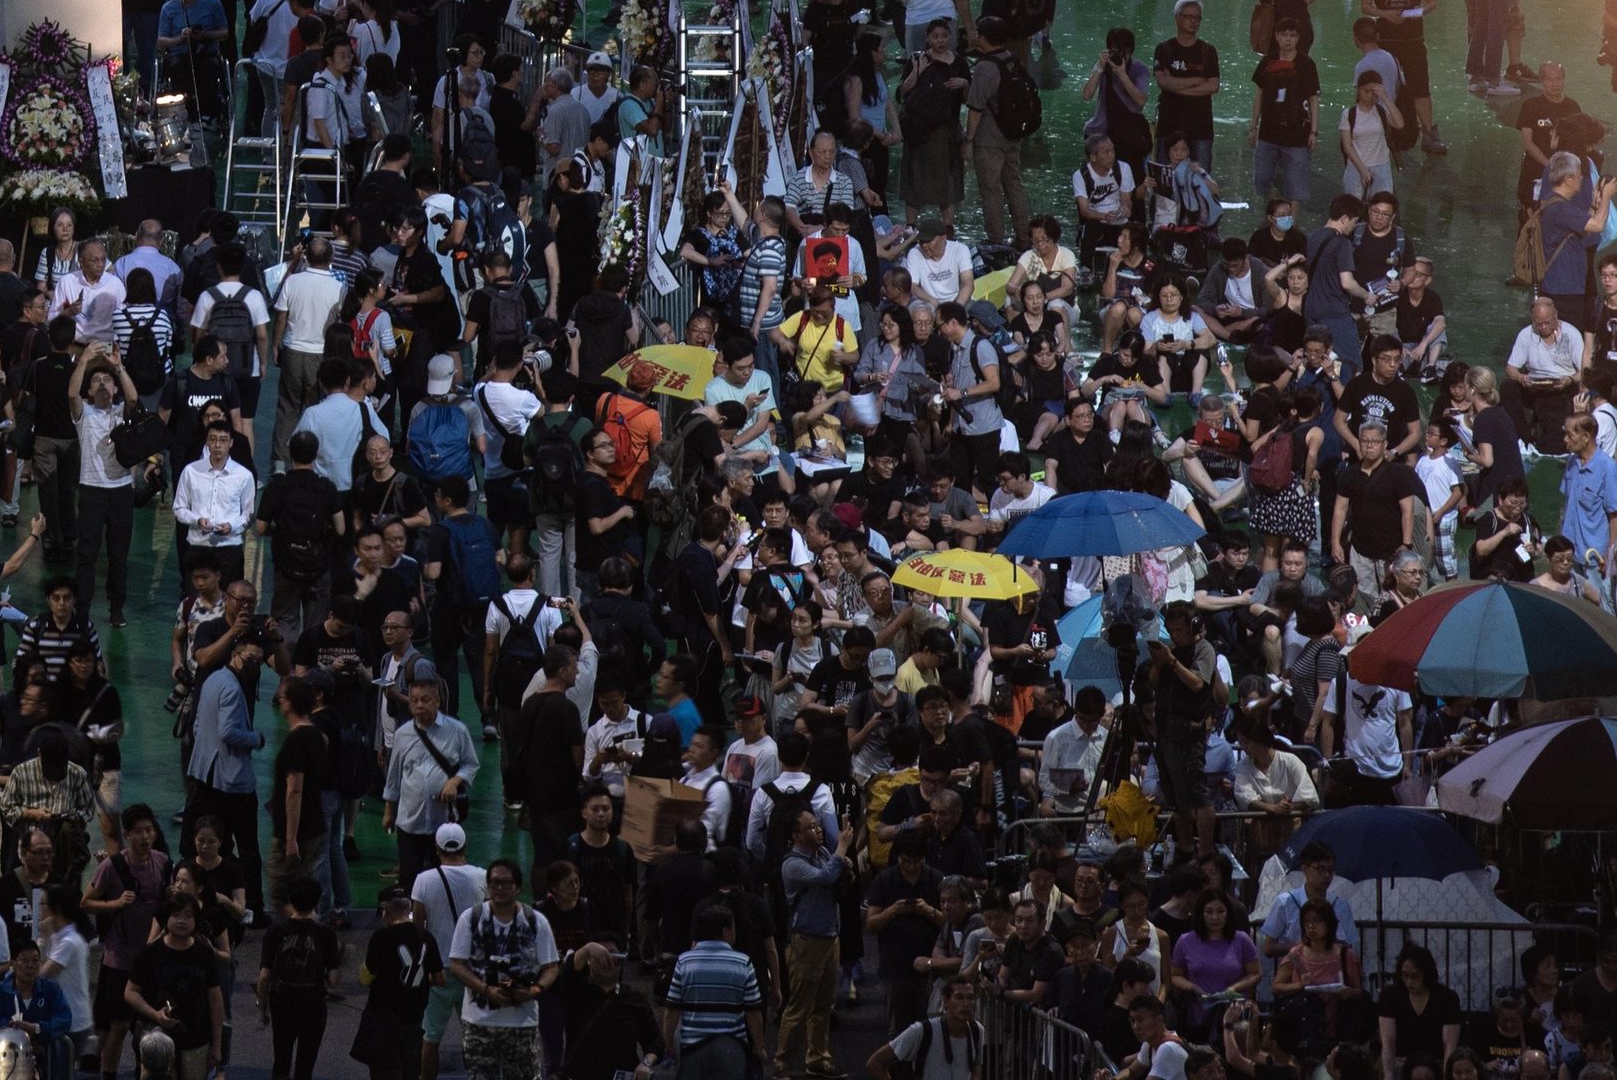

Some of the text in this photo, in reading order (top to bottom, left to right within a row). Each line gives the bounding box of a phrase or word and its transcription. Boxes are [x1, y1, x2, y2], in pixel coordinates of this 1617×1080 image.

[1094, 183, 1115, 196] NIKE
[1360, 395, 1396, 413] REVOLUTION
[993, 769, 1006, 808] YONEX
